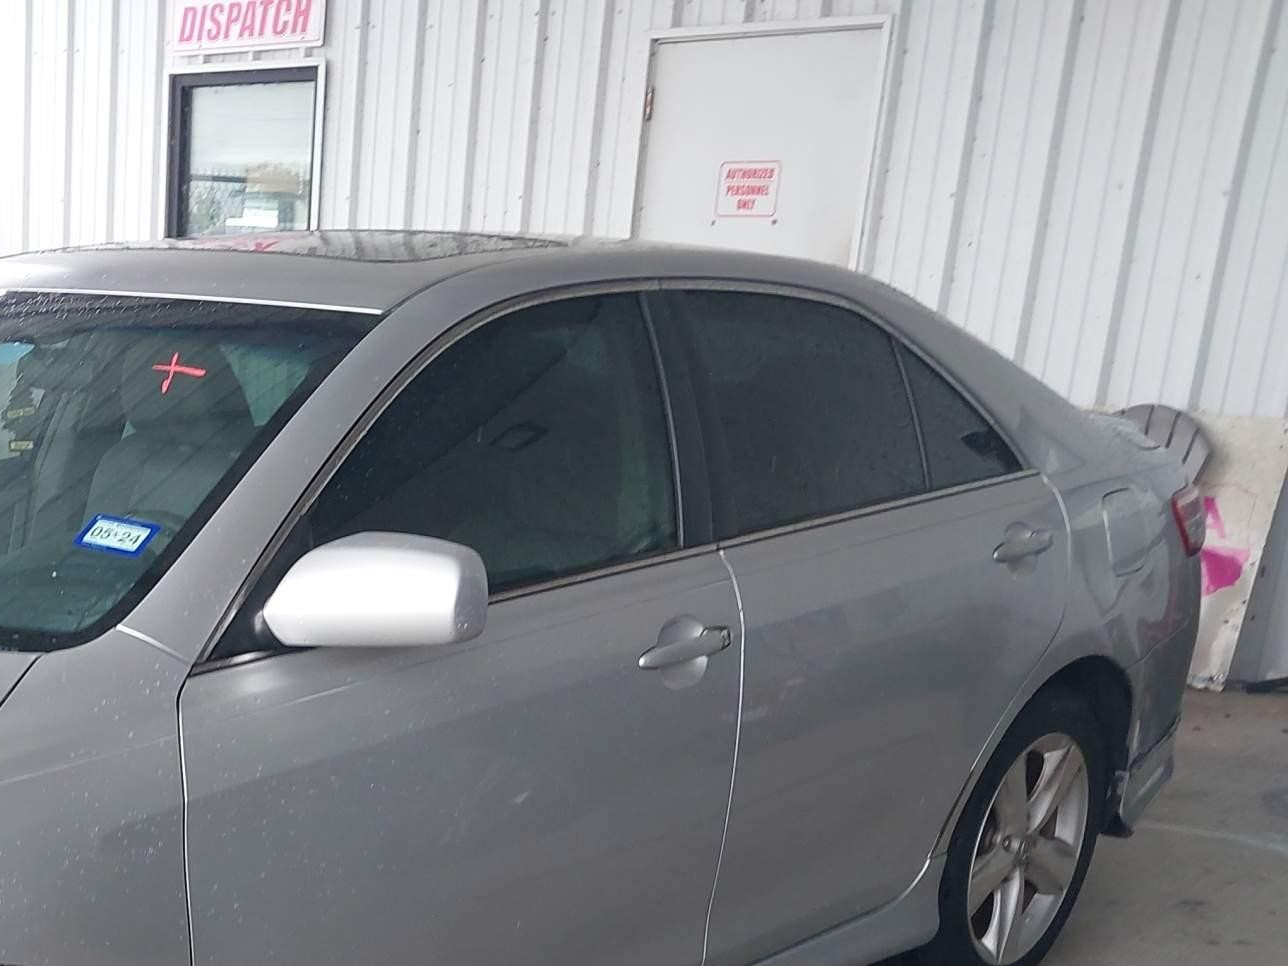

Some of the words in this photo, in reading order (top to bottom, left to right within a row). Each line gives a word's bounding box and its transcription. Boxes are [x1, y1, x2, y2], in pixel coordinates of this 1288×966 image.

[178, 0, 313, 43] DISPATCH
[726, 168, 775, 179] AUTHORIZED
[726, 185, 769, 196] PERSONNEL
[737, 199, 756, 209] ONLY
